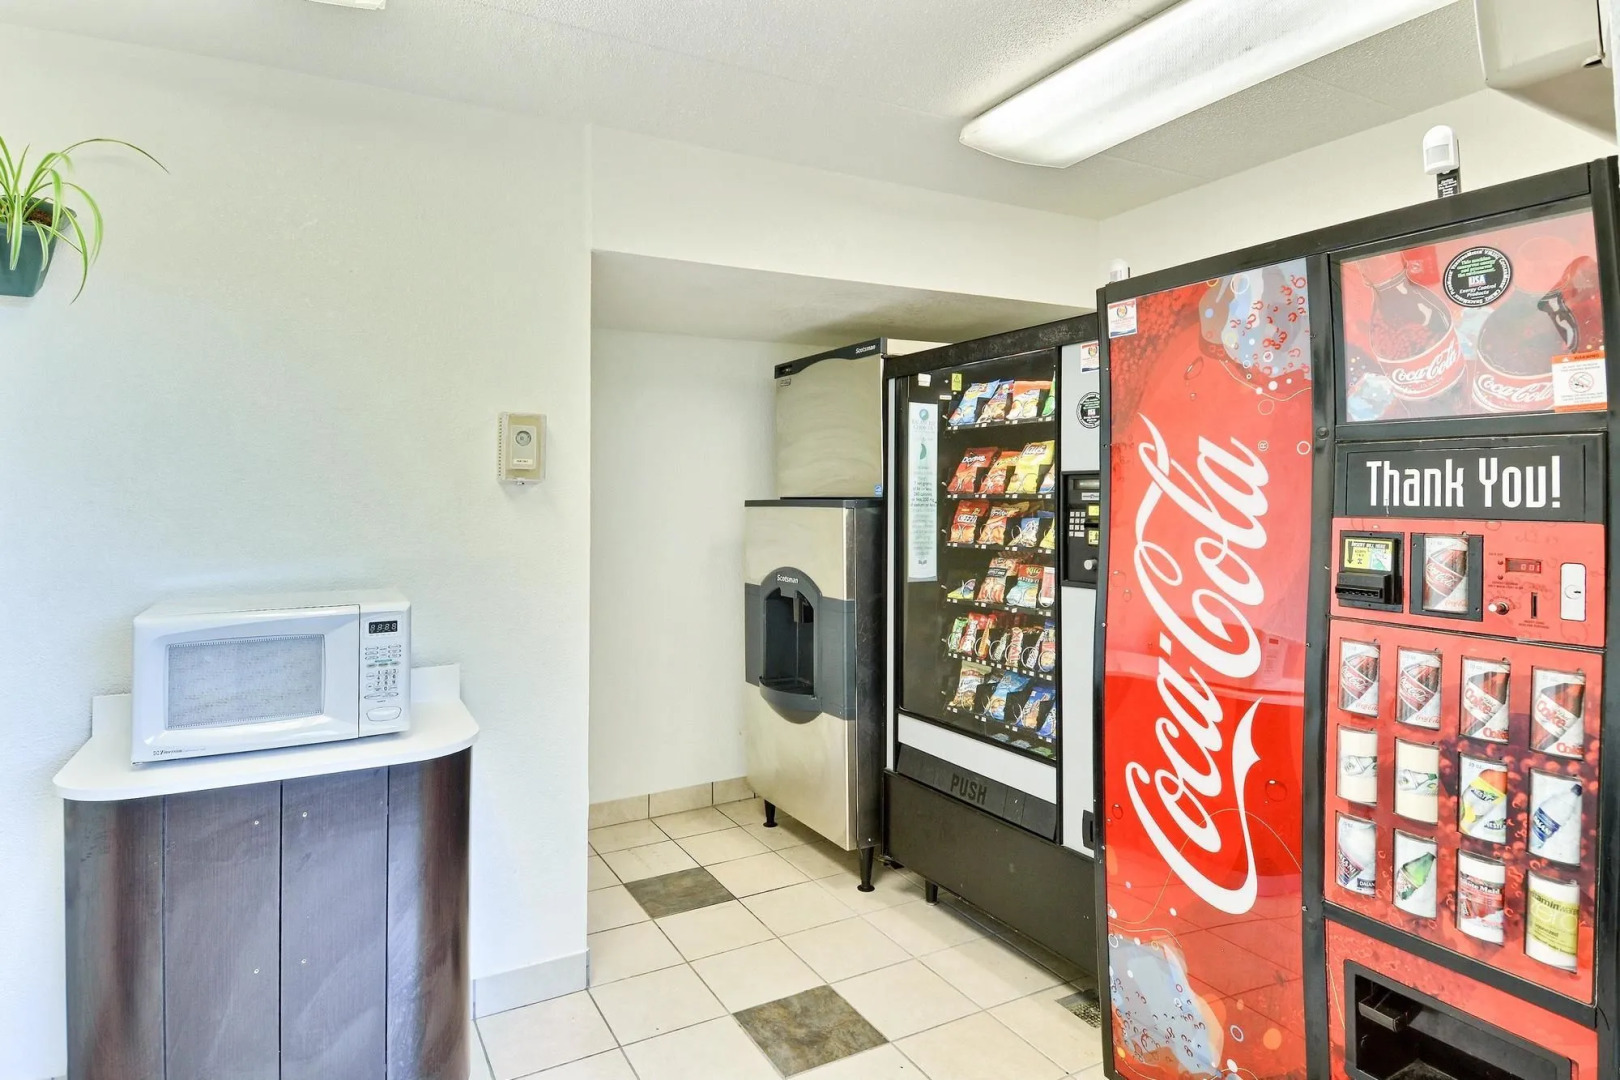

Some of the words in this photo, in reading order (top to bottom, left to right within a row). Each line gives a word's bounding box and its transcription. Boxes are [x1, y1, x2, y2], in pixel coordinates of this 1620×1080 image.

[1470, 274, 1487, 286] USA
[855, 344, 876, 354] Scotsman
[1392, 336, 1457, 384] Coca-Cola
[961, 454, 987, 464] Doritos
[1365, 458, 1465, 508] Thank
[1478, 455, 1561, 509] You!
[776, 574, 799, 584] Scotsman
[1125, 412, 1270, 916] Coca-Cola
[1465, 687, 1492, 715] Coke
[1536, 700, 1566, 729] Coke
[950, 773, 988, 806] PUSH
